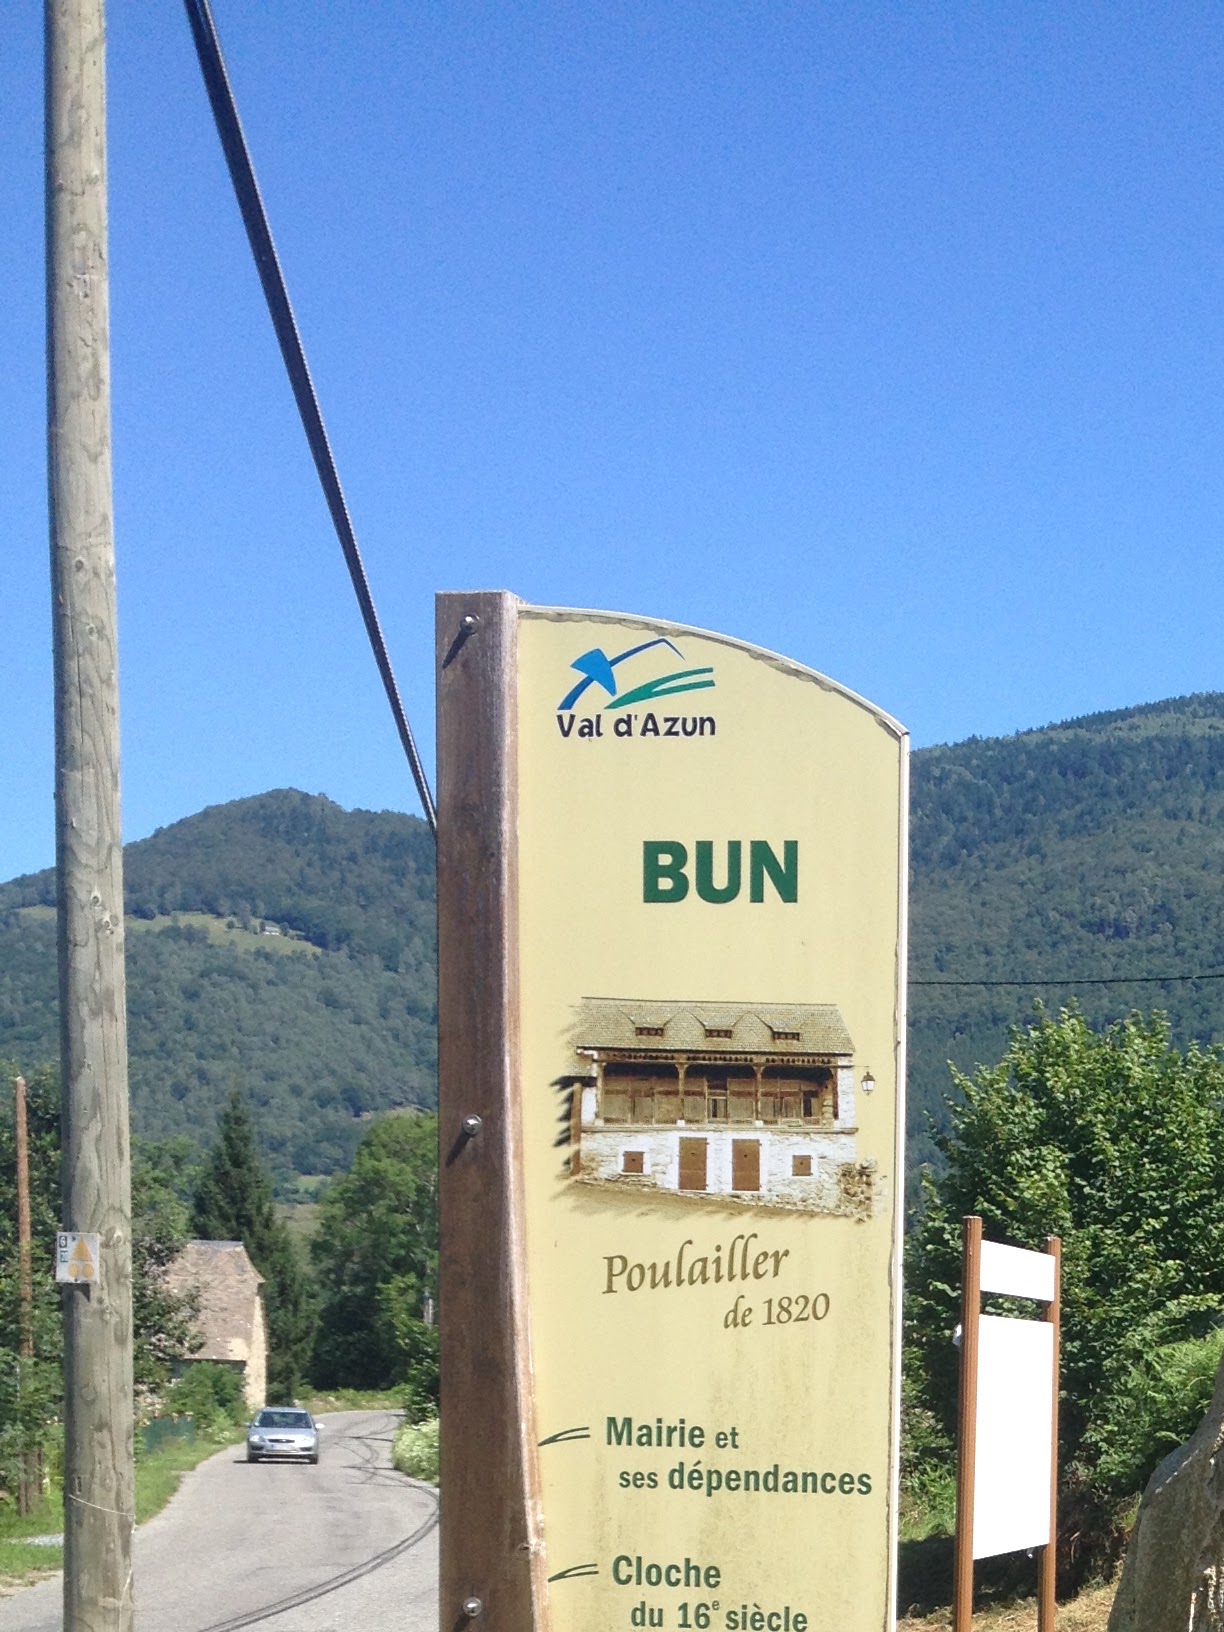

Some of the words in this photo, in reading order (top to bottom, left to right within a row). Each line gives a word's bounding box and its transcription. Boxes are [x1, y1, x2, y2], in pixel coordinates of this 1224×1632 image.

[556, 713, 604, 738] Val
[613, 712, 717, 738] d'Azun
[642, 840, 799, 905] BUN
[601, 1232, 791, 1295] Poulailler
[723, 1294, 753, 1329] de
[762, 1292, 831, 1326] 1820
[605, 1416, 706, 1449] Mairie
[714, 1426, 740, 1450] et
[618, 1470, 659, 1490] ses
[667, 1460, 873, 1497] dépendances
[612, 1554, 722, 1589] Cloche
[630, 1600, 664, 1628] du
[677, 1598, 721, 1630] 16e
[724, 1602, 809, 1632] siècle
